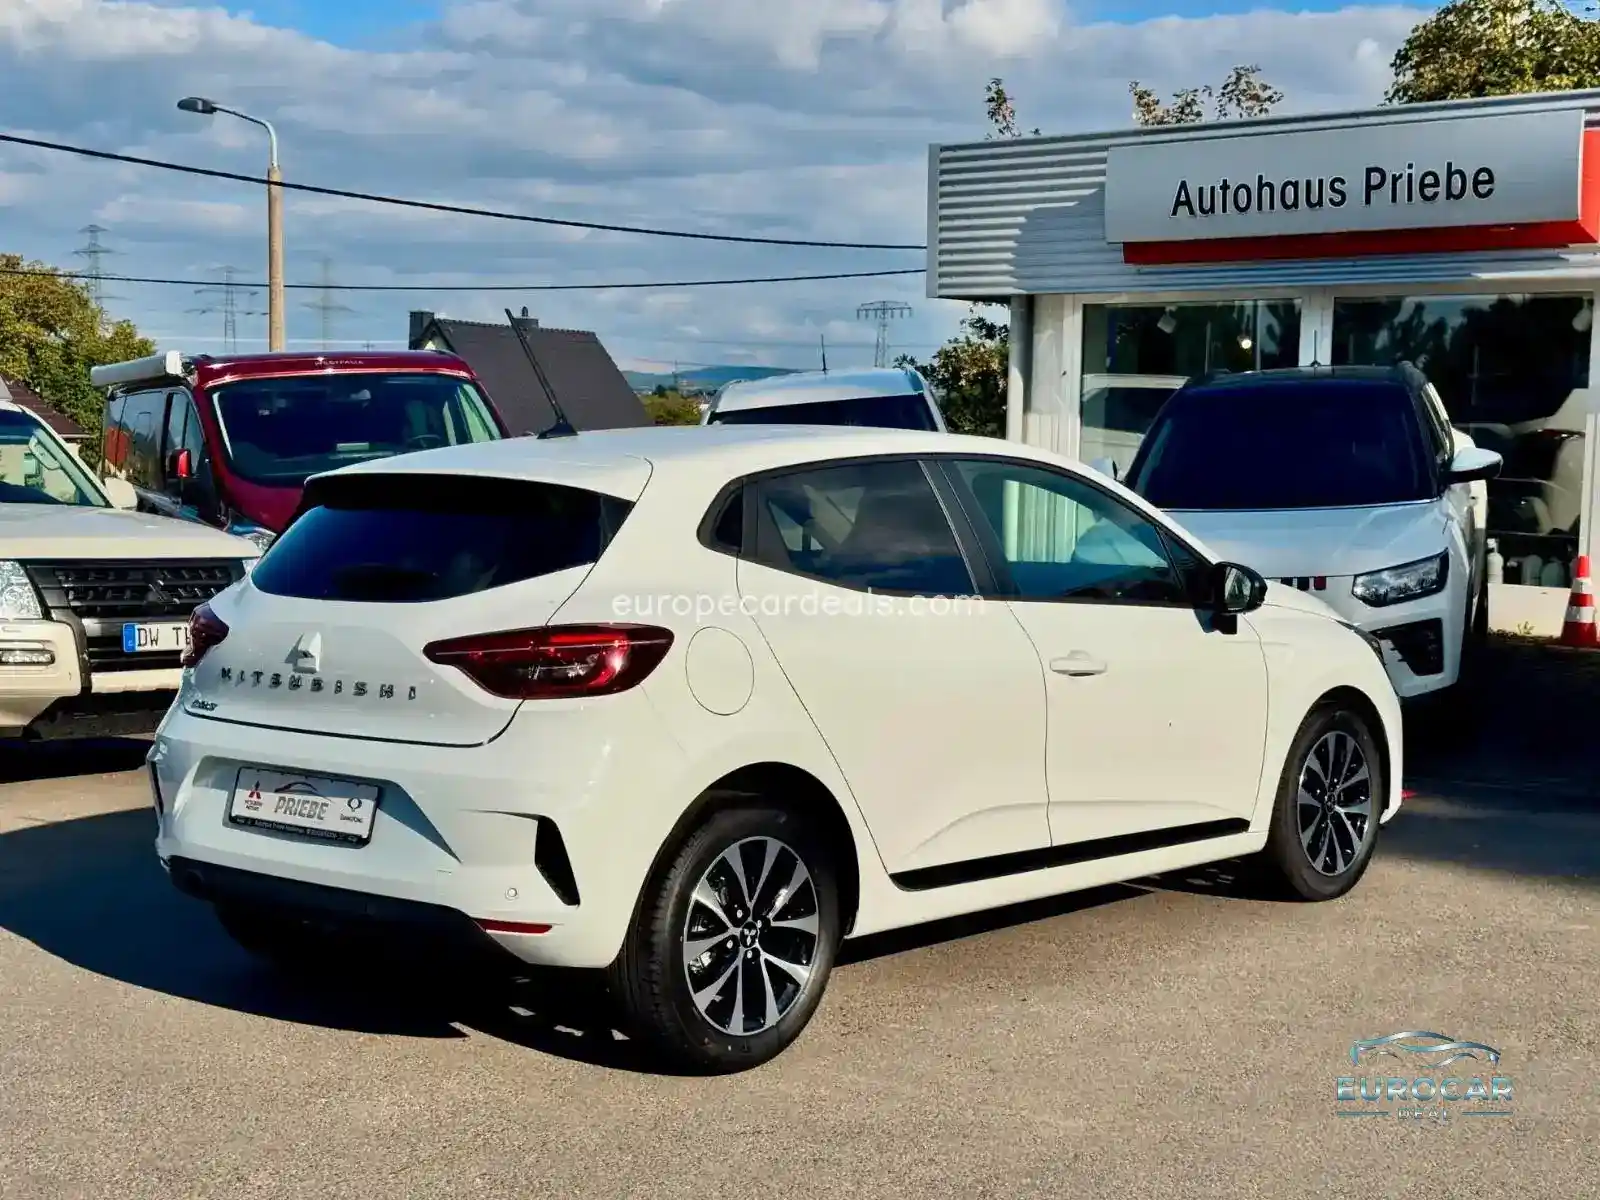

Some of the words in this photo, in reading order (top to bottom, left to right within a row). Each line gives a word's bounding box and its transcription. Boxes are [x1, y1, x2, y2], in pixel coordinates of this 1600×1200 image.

[1170, 174, 1347, 217] Autohaus
[1364, 161, 1495, 206] Priebe
[137, 627, 159, 647] DW
[221, 667, 417, 700] MITSUBISHI
[274, 796, 330, 821] PRIEBE
